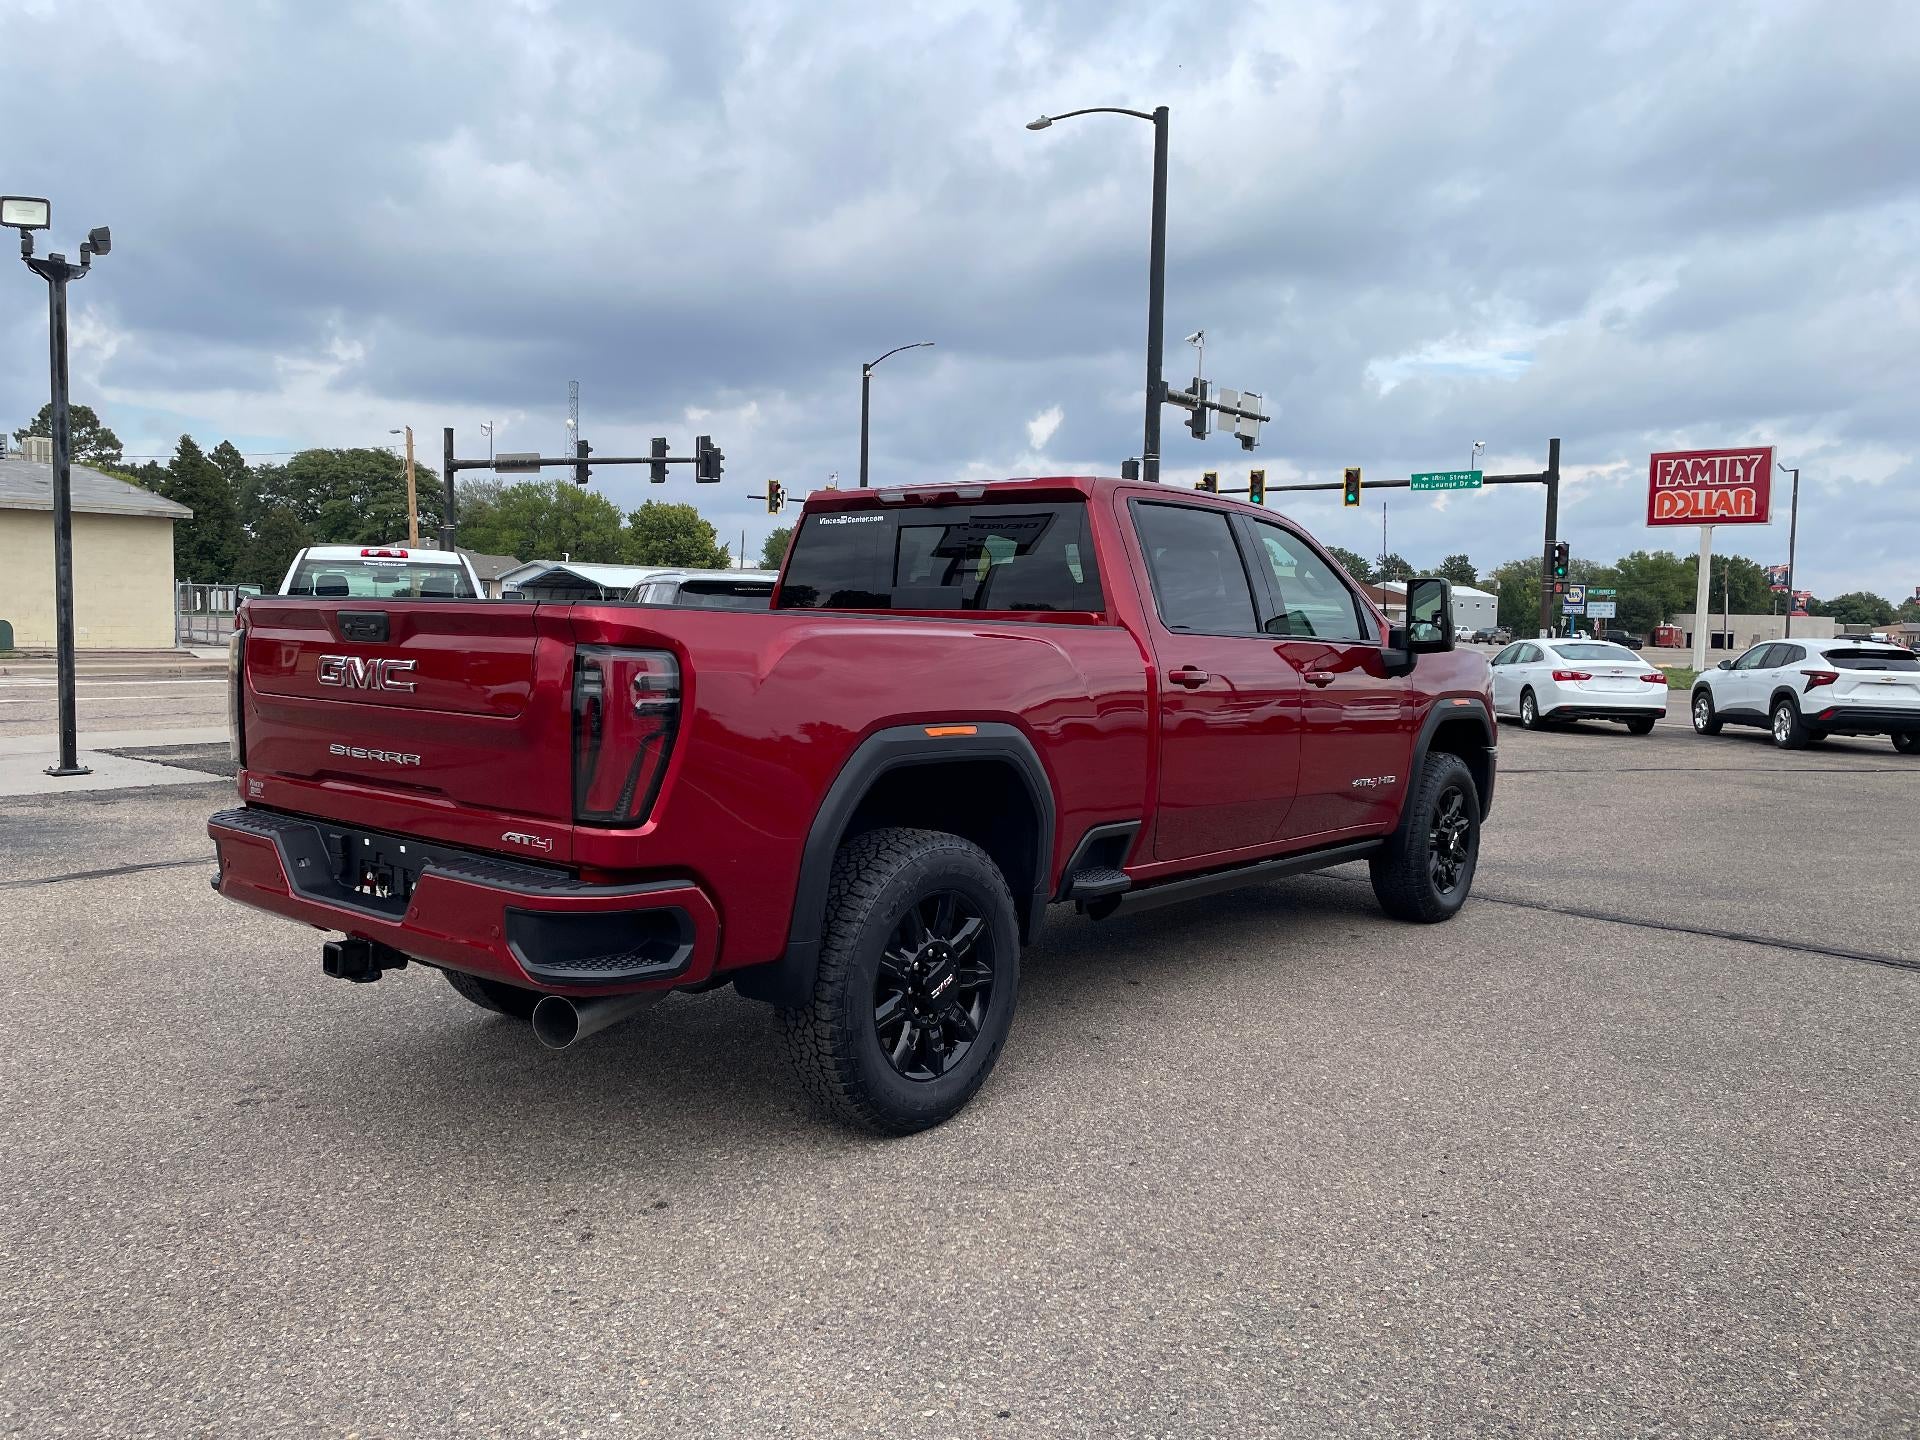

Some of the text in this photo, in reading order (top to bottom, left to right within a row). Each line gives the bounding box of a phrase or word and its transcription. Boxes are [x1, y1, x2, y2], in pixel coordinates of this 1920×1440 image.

[1431, 480, 1457, 489] Lounge
[1656, 455, 1763, 487] FAMILY
[1654, 487, 1756, 519] DOLLAR
[318, 654, 418, 693] GMC
[329, 743, 421, 766] SIERRA
[502, 831, 553, 853] AT4
